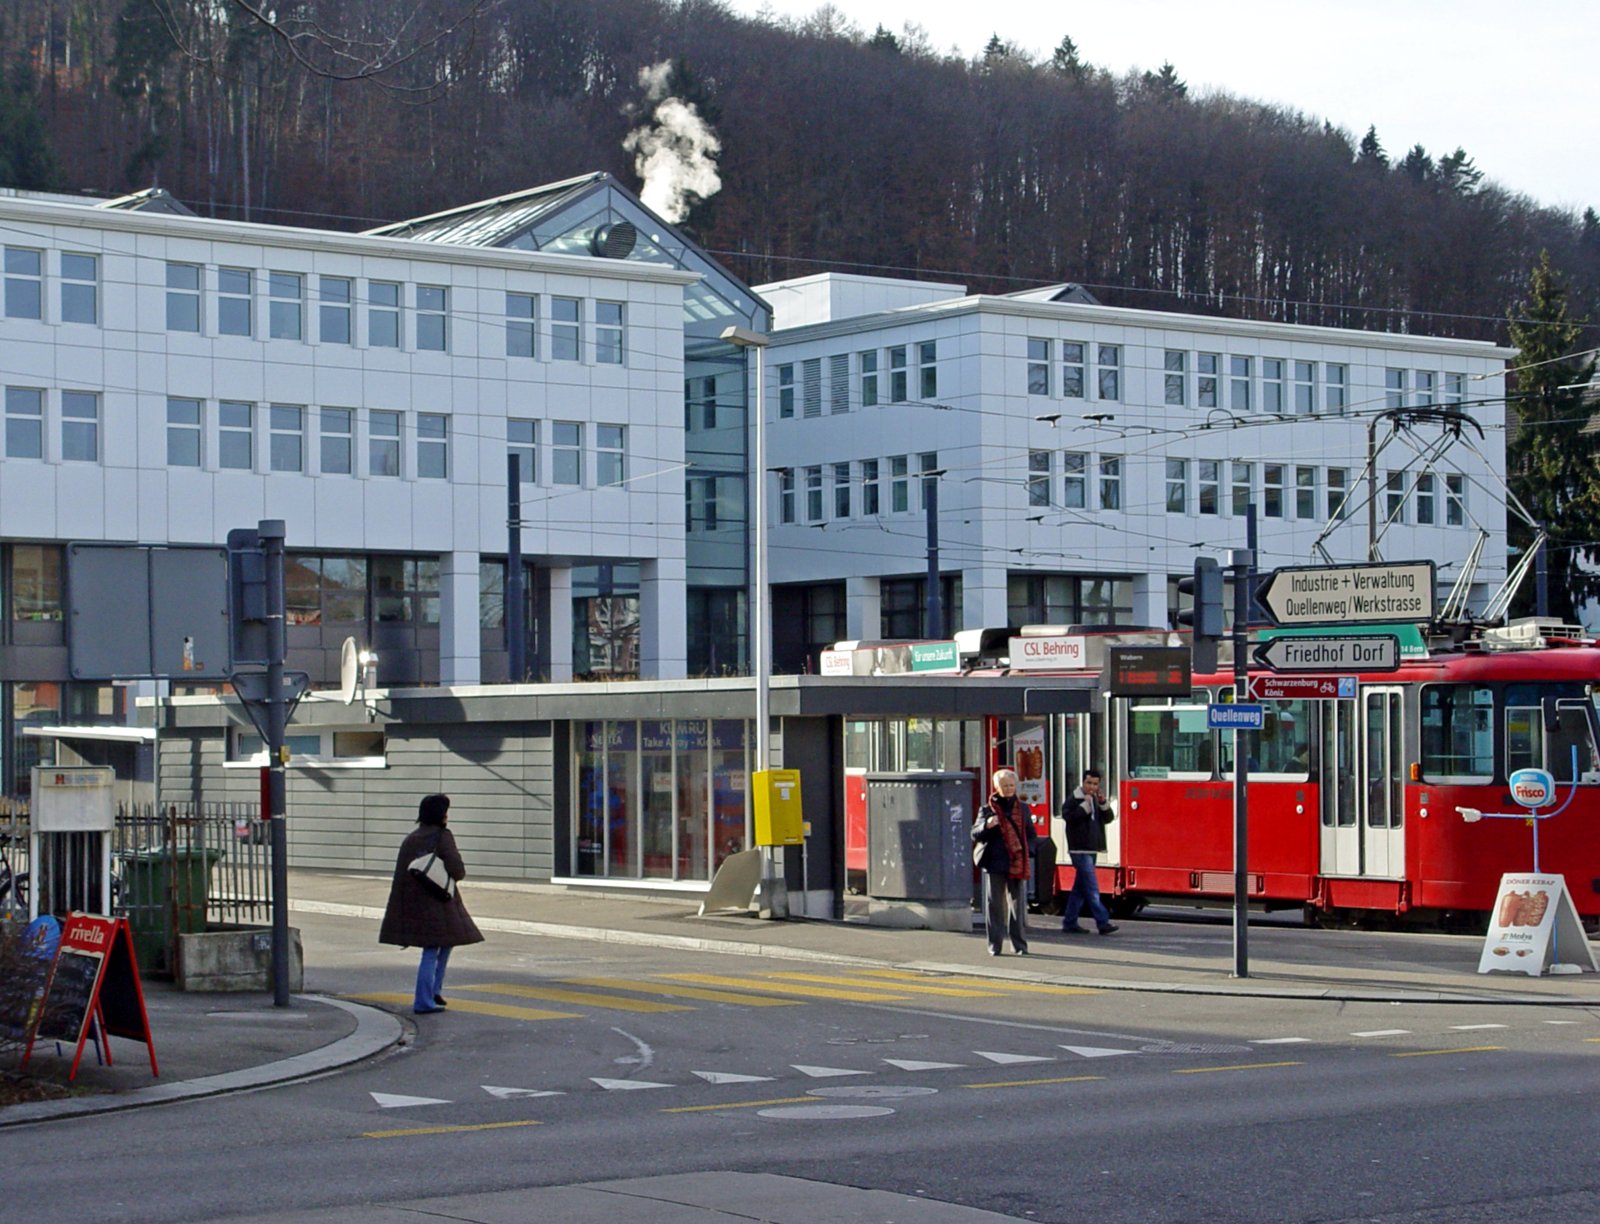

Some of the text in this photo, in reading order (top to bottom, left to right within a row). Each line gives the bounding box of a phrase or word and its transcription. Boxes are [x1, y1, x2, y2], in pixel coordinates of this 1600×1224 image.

[1291, 570, 1415, 593] Industrie + Verwaltung
[1024, 641, 1079, 658] CSL Behring
[1285, 643, 1385, 663] Friedhof Dorf
[1264, 679, 1318, 689] Schwarzenburg
[1264, 688, 1285, 697] Köniz
[1210, 707, 1261, 726] Quellenweg
[591, 734, 623, 745] NETEA
[1516, 785, 1545, 798] Frisco
[69, 922, 105, 945] rivella
